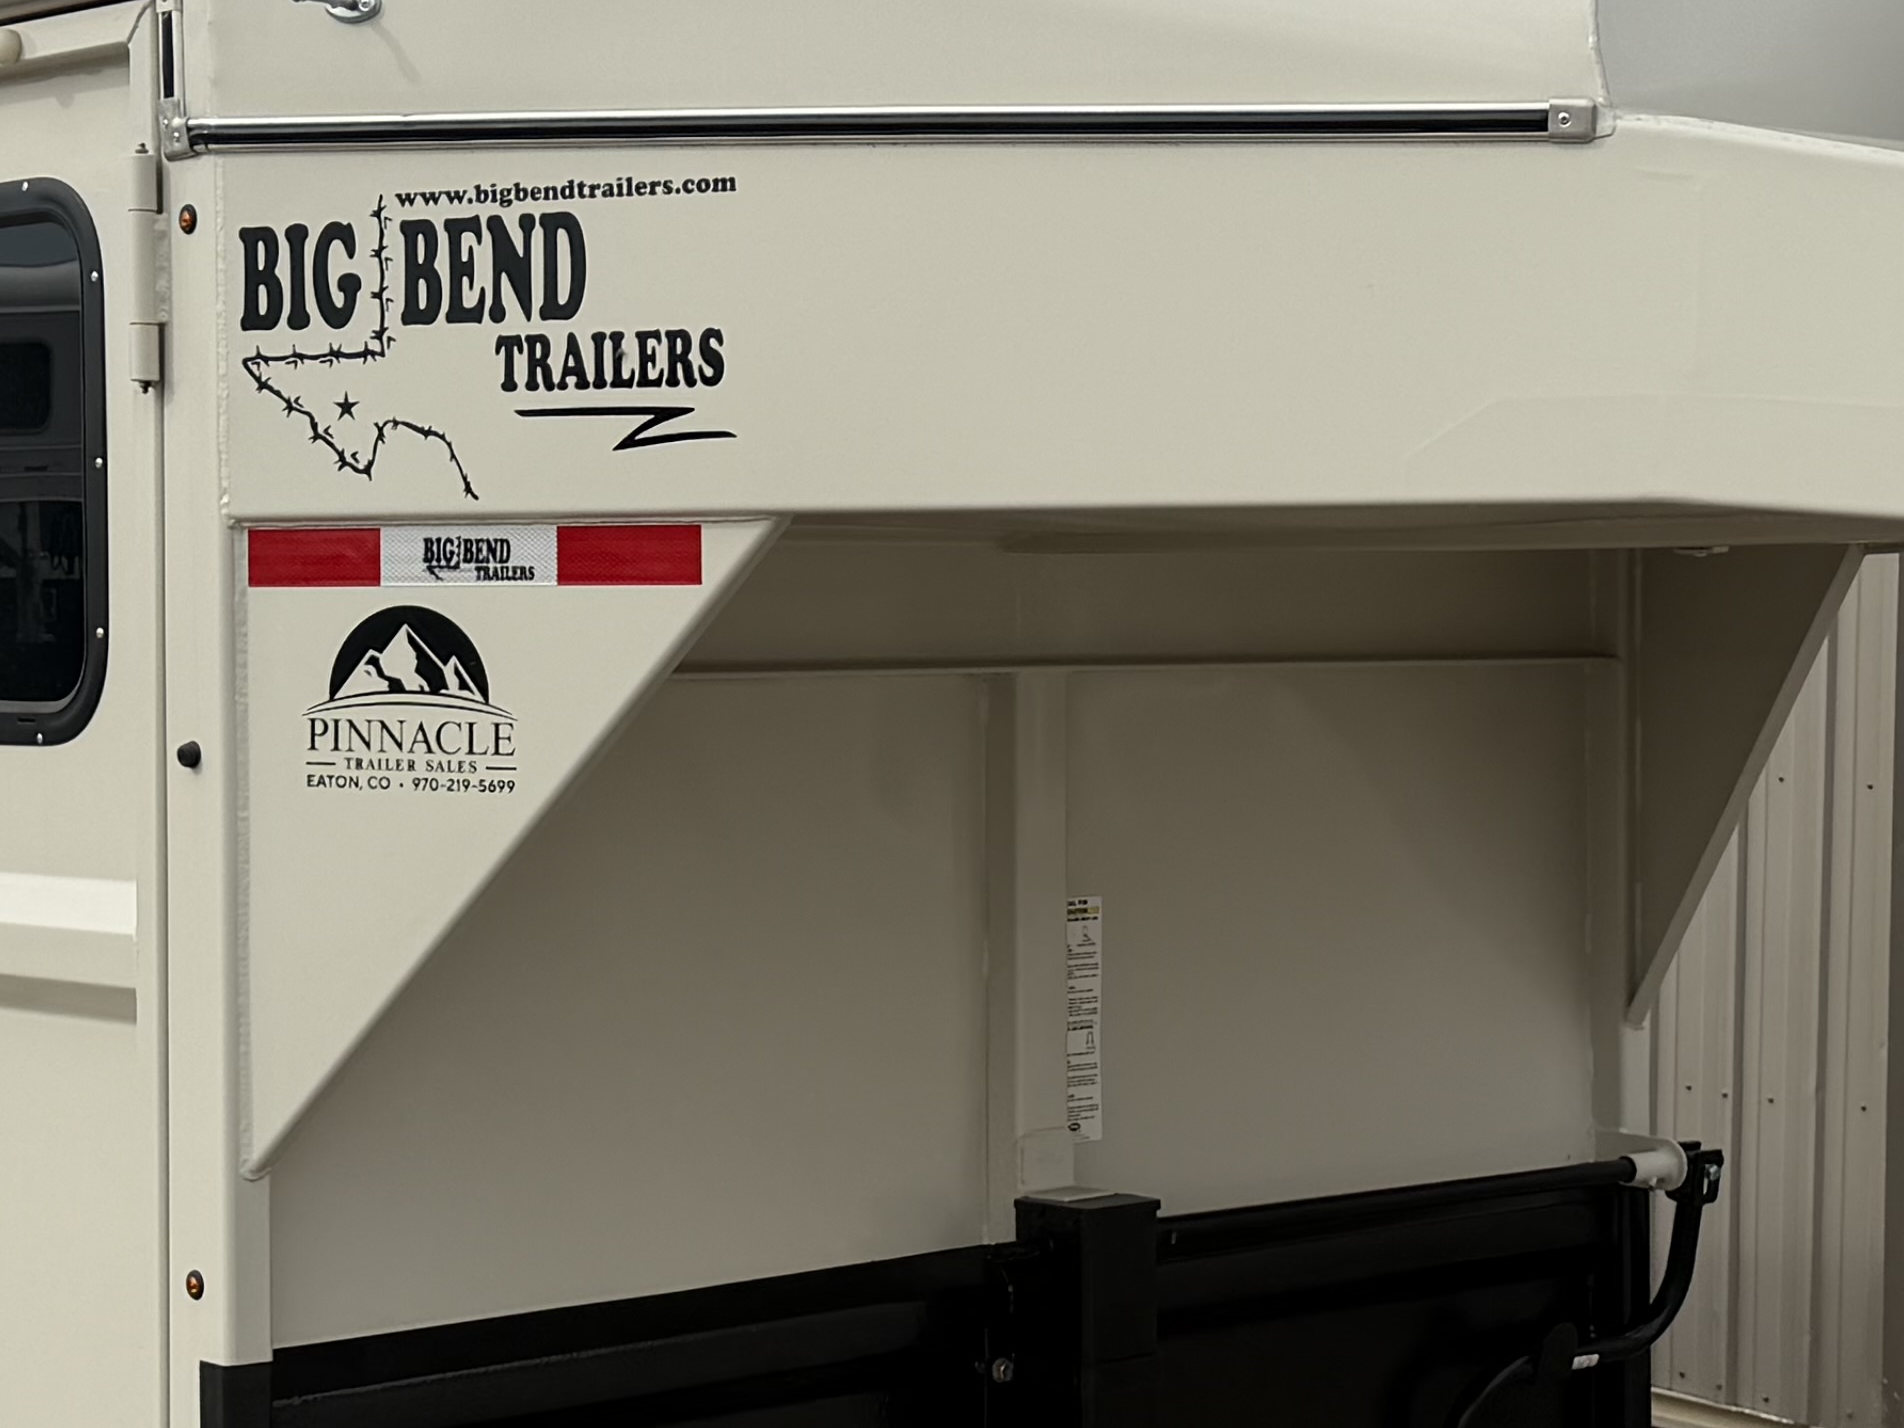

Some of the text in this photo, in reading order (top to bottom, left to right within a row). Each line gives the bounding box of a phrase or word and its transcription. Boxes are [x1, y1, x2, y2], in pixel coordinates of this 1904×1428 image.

[394, 175, 737, 208] www.bigbendtrailers.com
[239, 211, 587, 331] BIG BEND
[495, 327, 725, 392] TRAILERS
[422, 537, 511, 565] BIG BEND
[475, 565, 536, 581] TRAILERS
[306, 718, 516, 757] PINNACLE
[344, 757, 478, 774] TRAILER SALES
[306, 774, 516, 794] EATON, CO 970-219-5699
